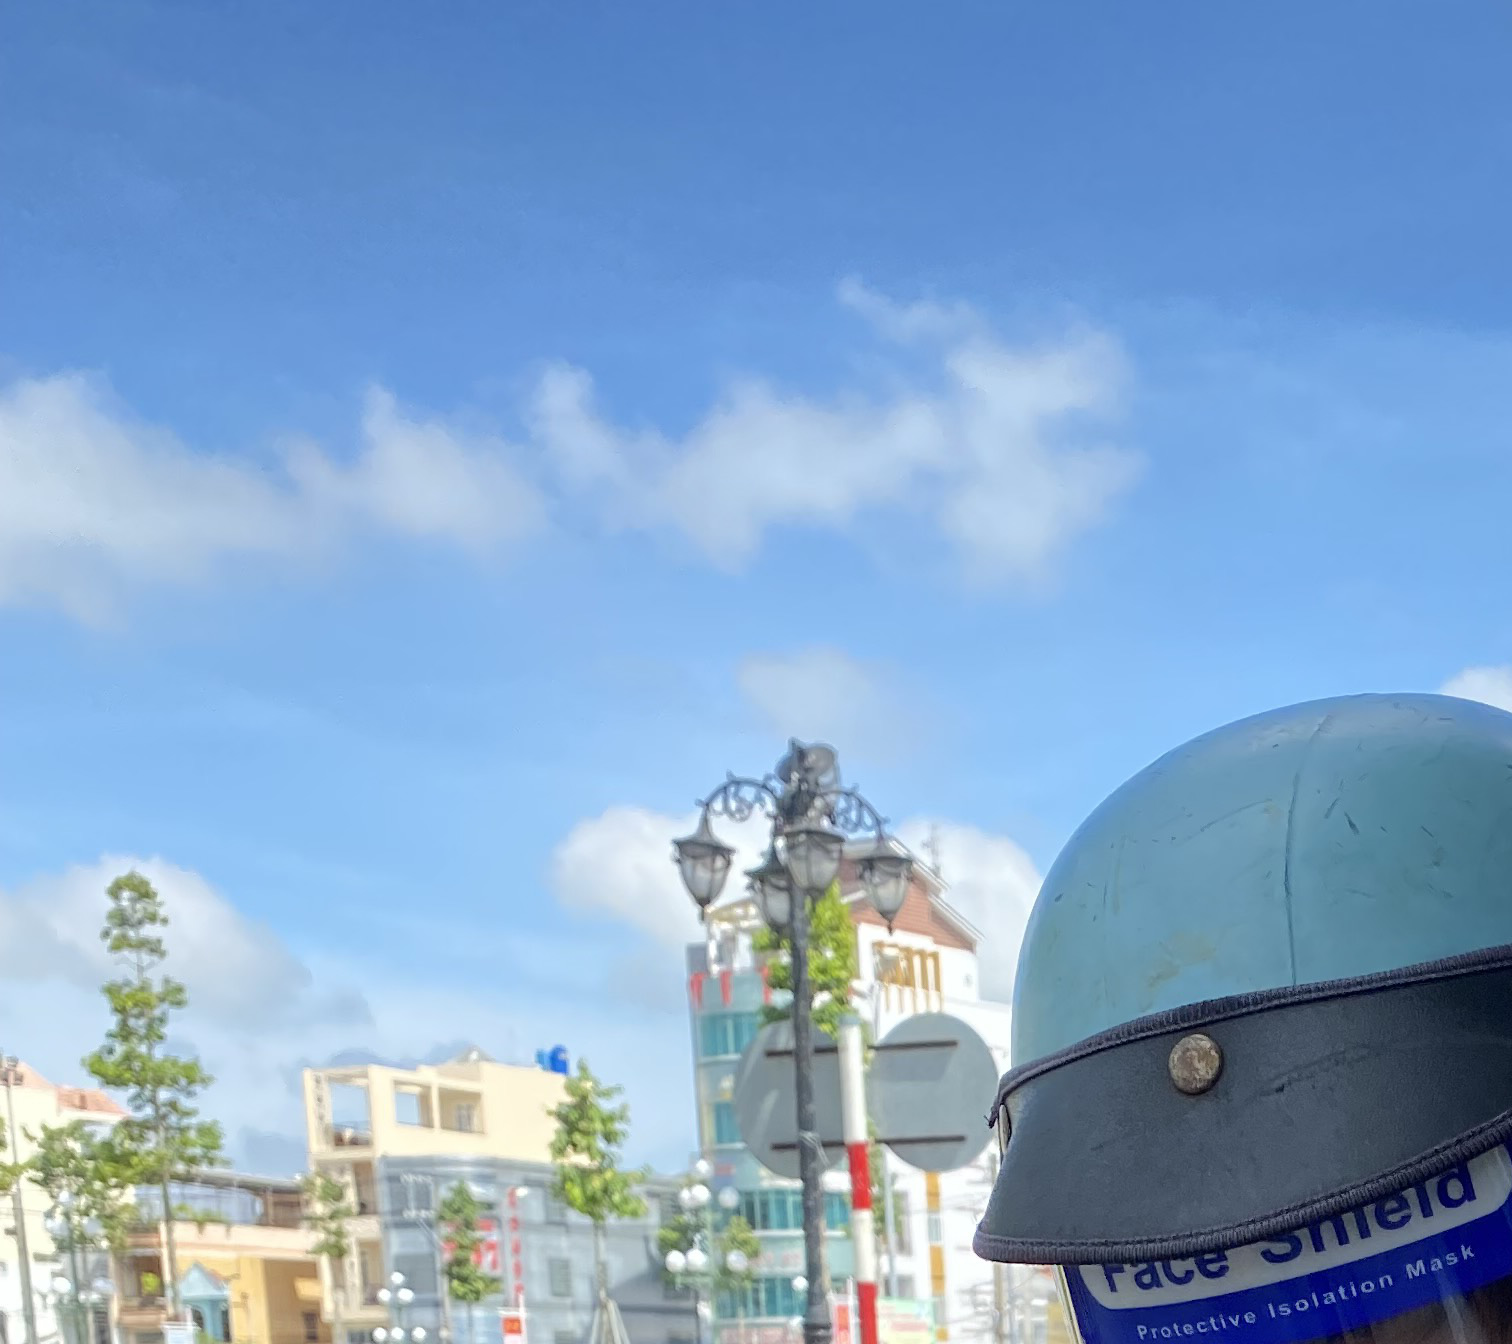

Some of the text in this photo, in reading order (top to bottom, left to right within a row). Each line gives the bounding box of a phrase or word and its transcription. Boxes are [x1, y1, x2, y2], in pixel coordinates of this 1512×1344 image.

[1137, 1243, 1475, 1341] Protective Isolation Mask
